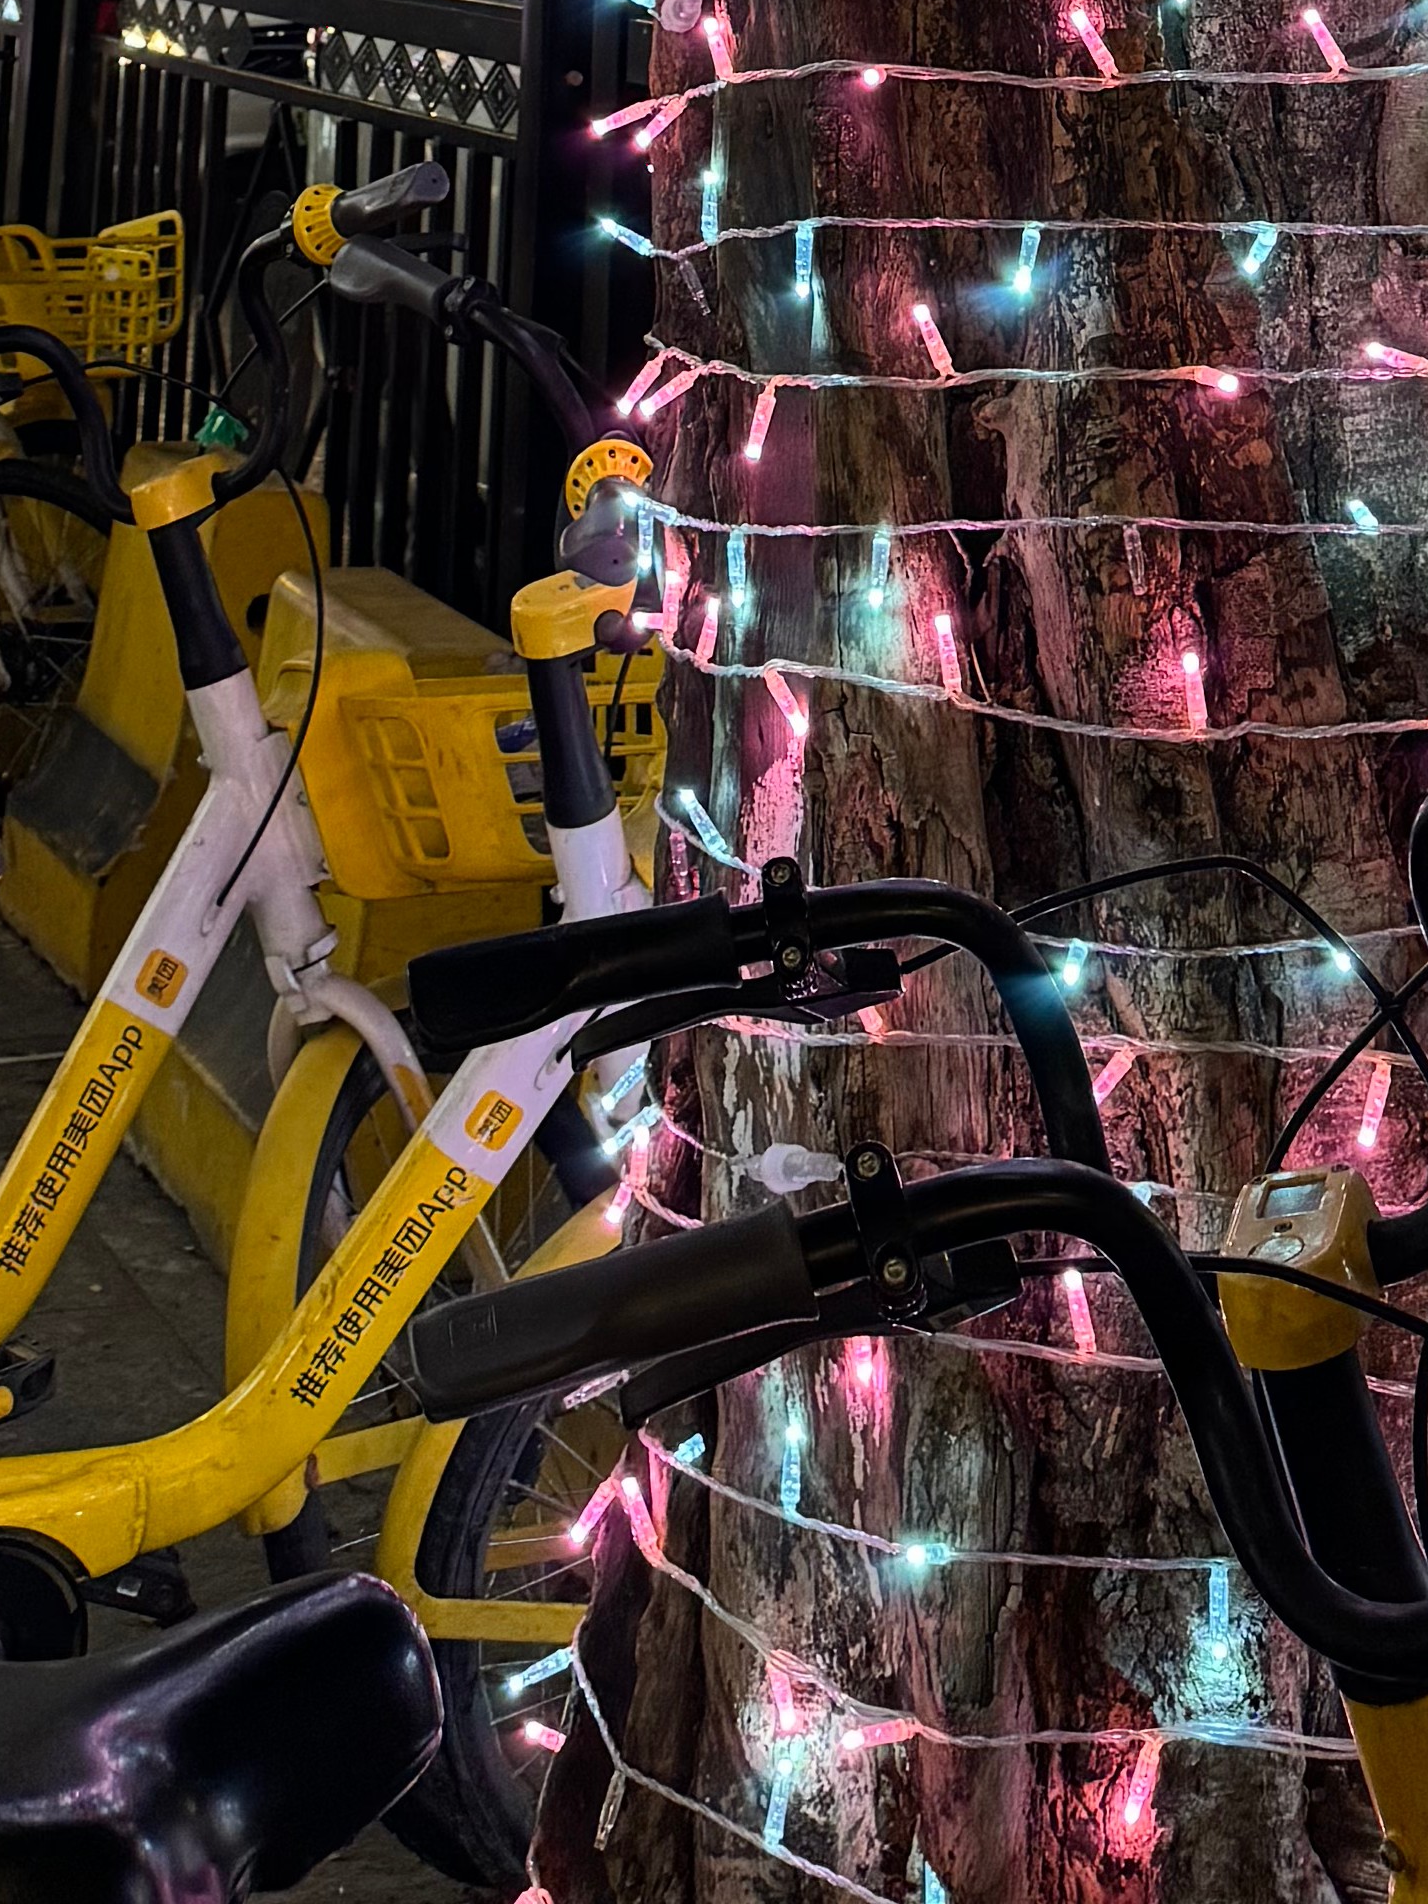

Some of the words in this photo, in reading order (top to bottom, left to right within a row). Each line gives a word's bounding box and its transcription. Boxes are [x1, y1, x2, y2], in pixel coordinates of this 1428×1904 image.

[147, 957, 178, 1001] 美团
[289, 1166, 469, 1408] 推荐使用美团App
